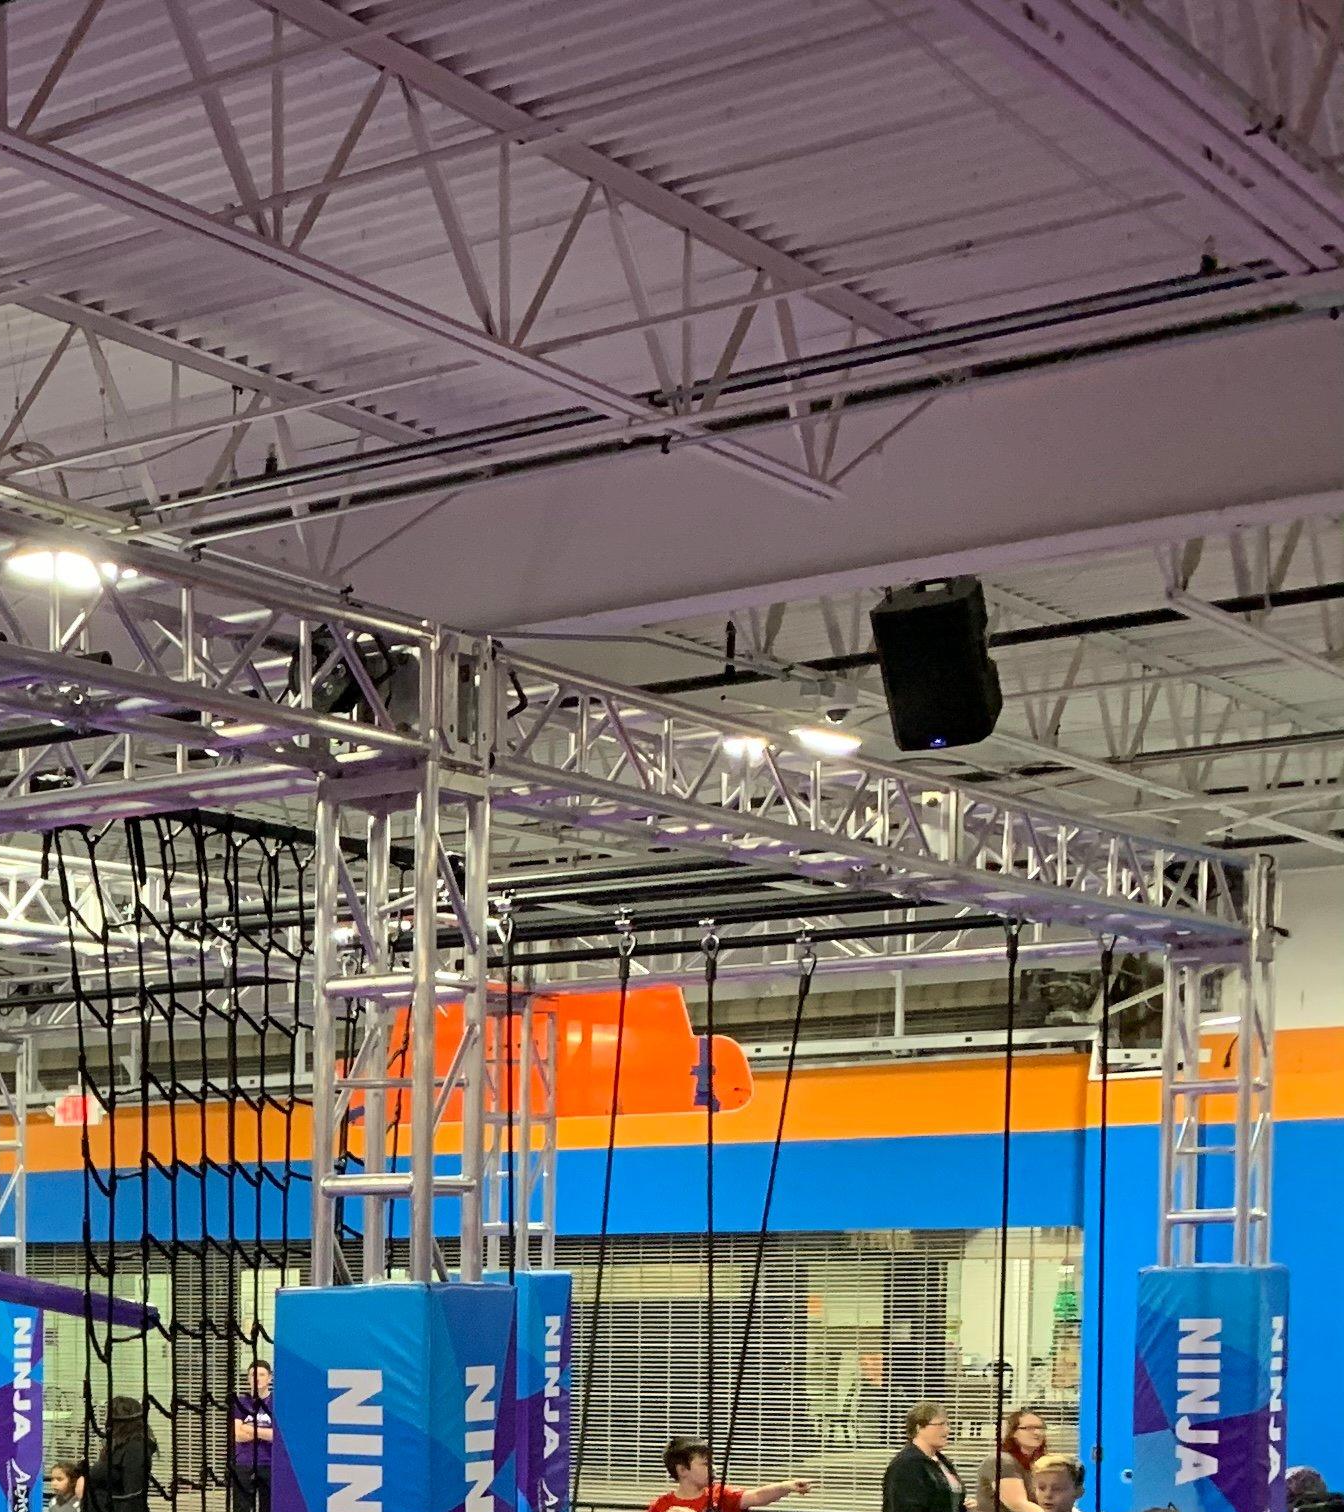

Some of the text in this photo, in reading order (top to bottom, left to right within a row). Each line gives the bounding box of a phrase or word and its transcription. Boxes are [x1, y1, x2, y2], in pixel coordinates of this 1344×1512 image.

[12, 1317, 32, 1443] NINJA
[543, 1315, 561, 1460] NINJA
[1174, 1317, 1222, 1487] NINJA
